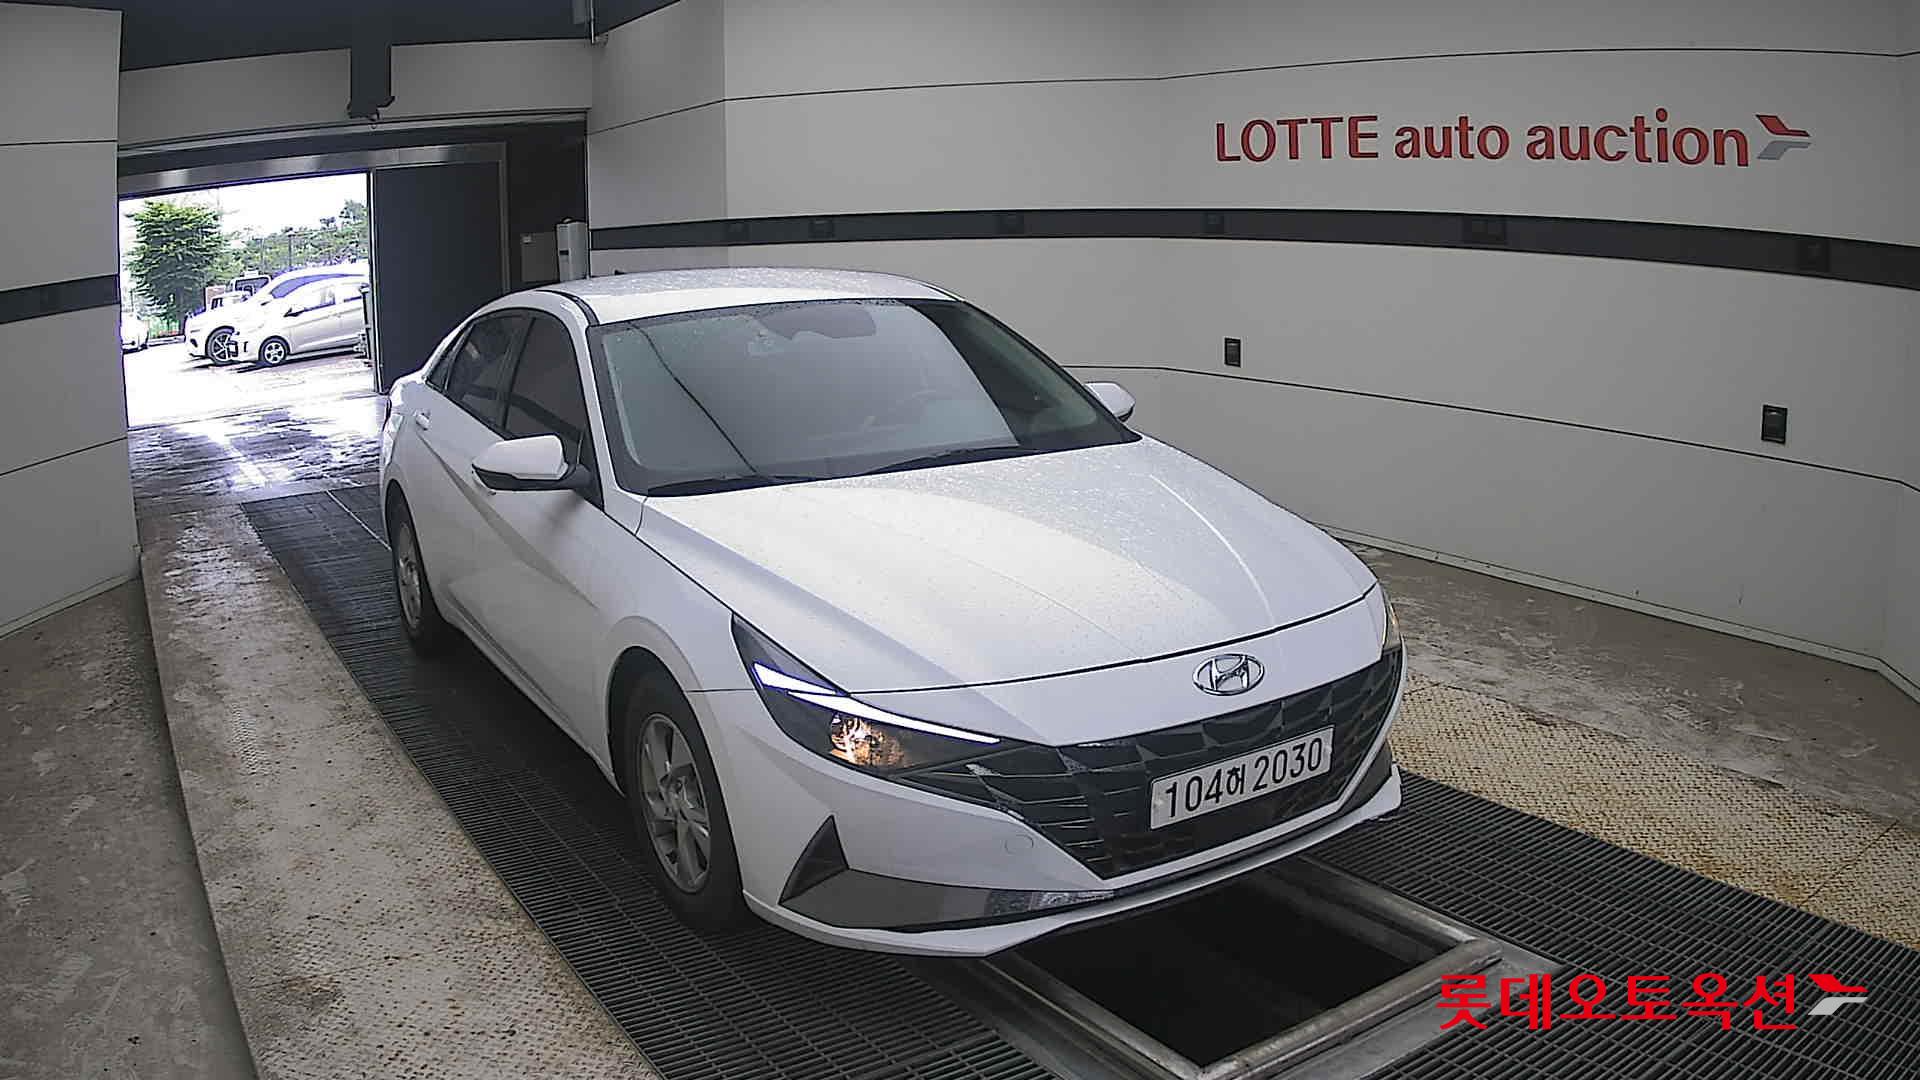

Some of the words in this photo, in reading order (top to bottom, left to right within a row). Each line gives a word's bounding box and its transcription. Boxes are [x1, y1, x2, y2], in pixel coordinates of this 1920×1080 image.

[1215, 115, 1379, 162] LOTTE
[1393, 115, 1510, 161] auto
[1525, 108, 1750, 167] auction
[1165, 764, 1246, 818] 104허
[1252, 737, 1323, 792] 2030
